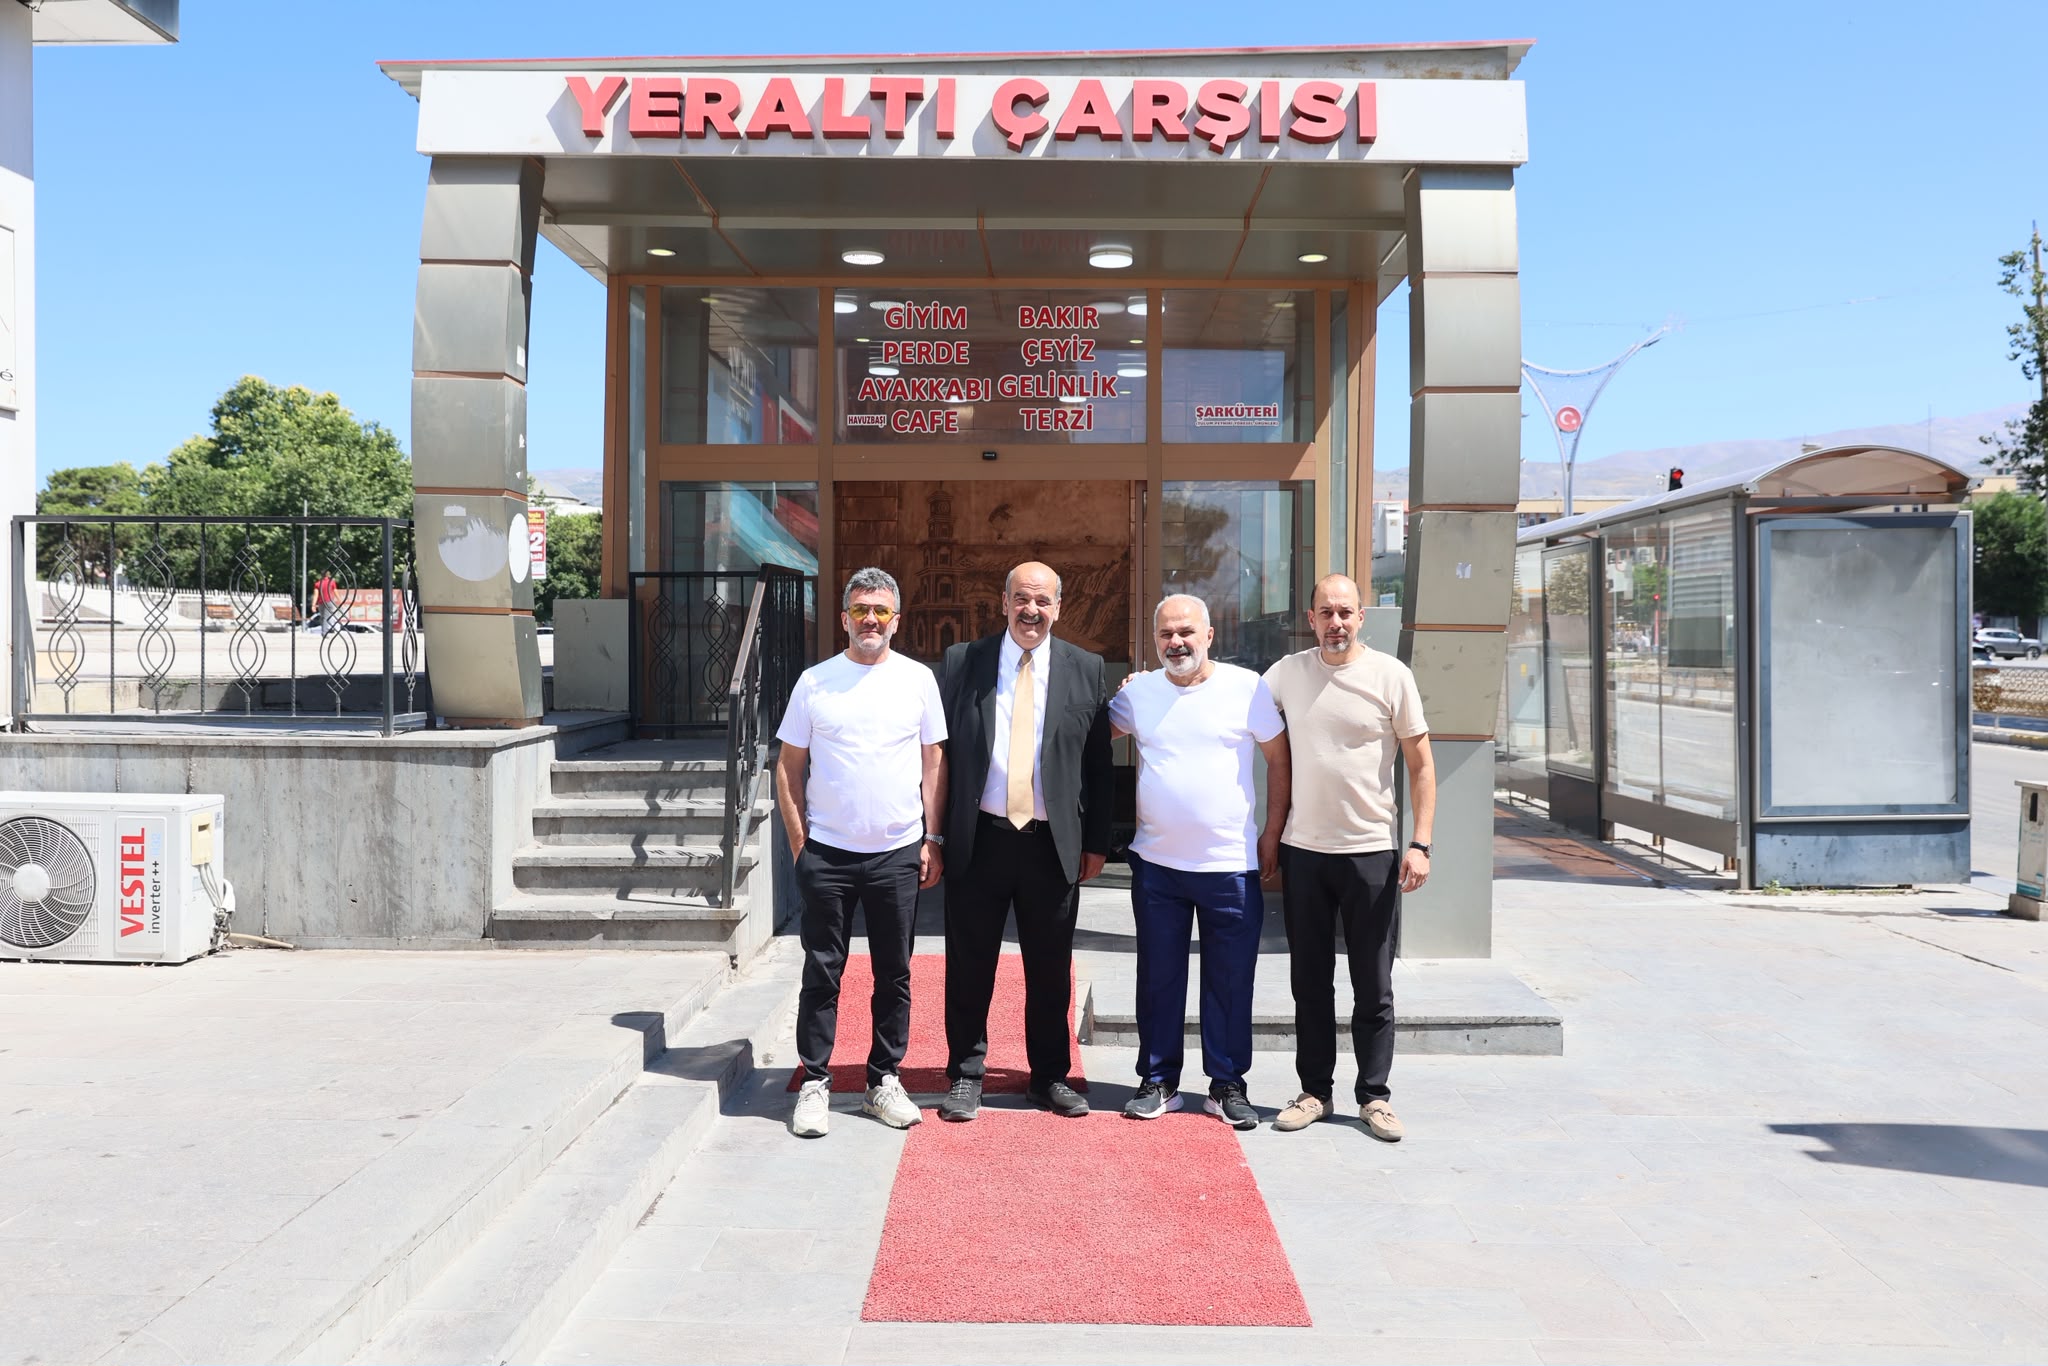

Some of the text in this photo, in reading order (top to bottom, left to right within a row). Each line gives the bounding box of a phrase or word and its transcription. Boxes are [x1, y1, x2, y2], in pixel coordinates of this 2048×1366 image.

[565, 76, 1377, 155] YERALTI ÇARŞISI
[884, 301, 967, 330] GİYİM
[1019, 306, 1099, 329] BAKIR
[882, 341, 970, 364] PERDE
[1021, 334, 1096, 366] ÇEYİZ
[858, 378, 992, 401] AYAKKABI
[998, 370, 1118, 398] GELİNLİK
[847, 414, 887, 428] HAVUZBAŞI
[891, 409, 959, 433] CAFE
[1019, 404, 1094, 431] TERZİ
[1195, 403, 1278, 421] ŞARKÜTERİ
[121, 827, 145, 938] VESTEL
